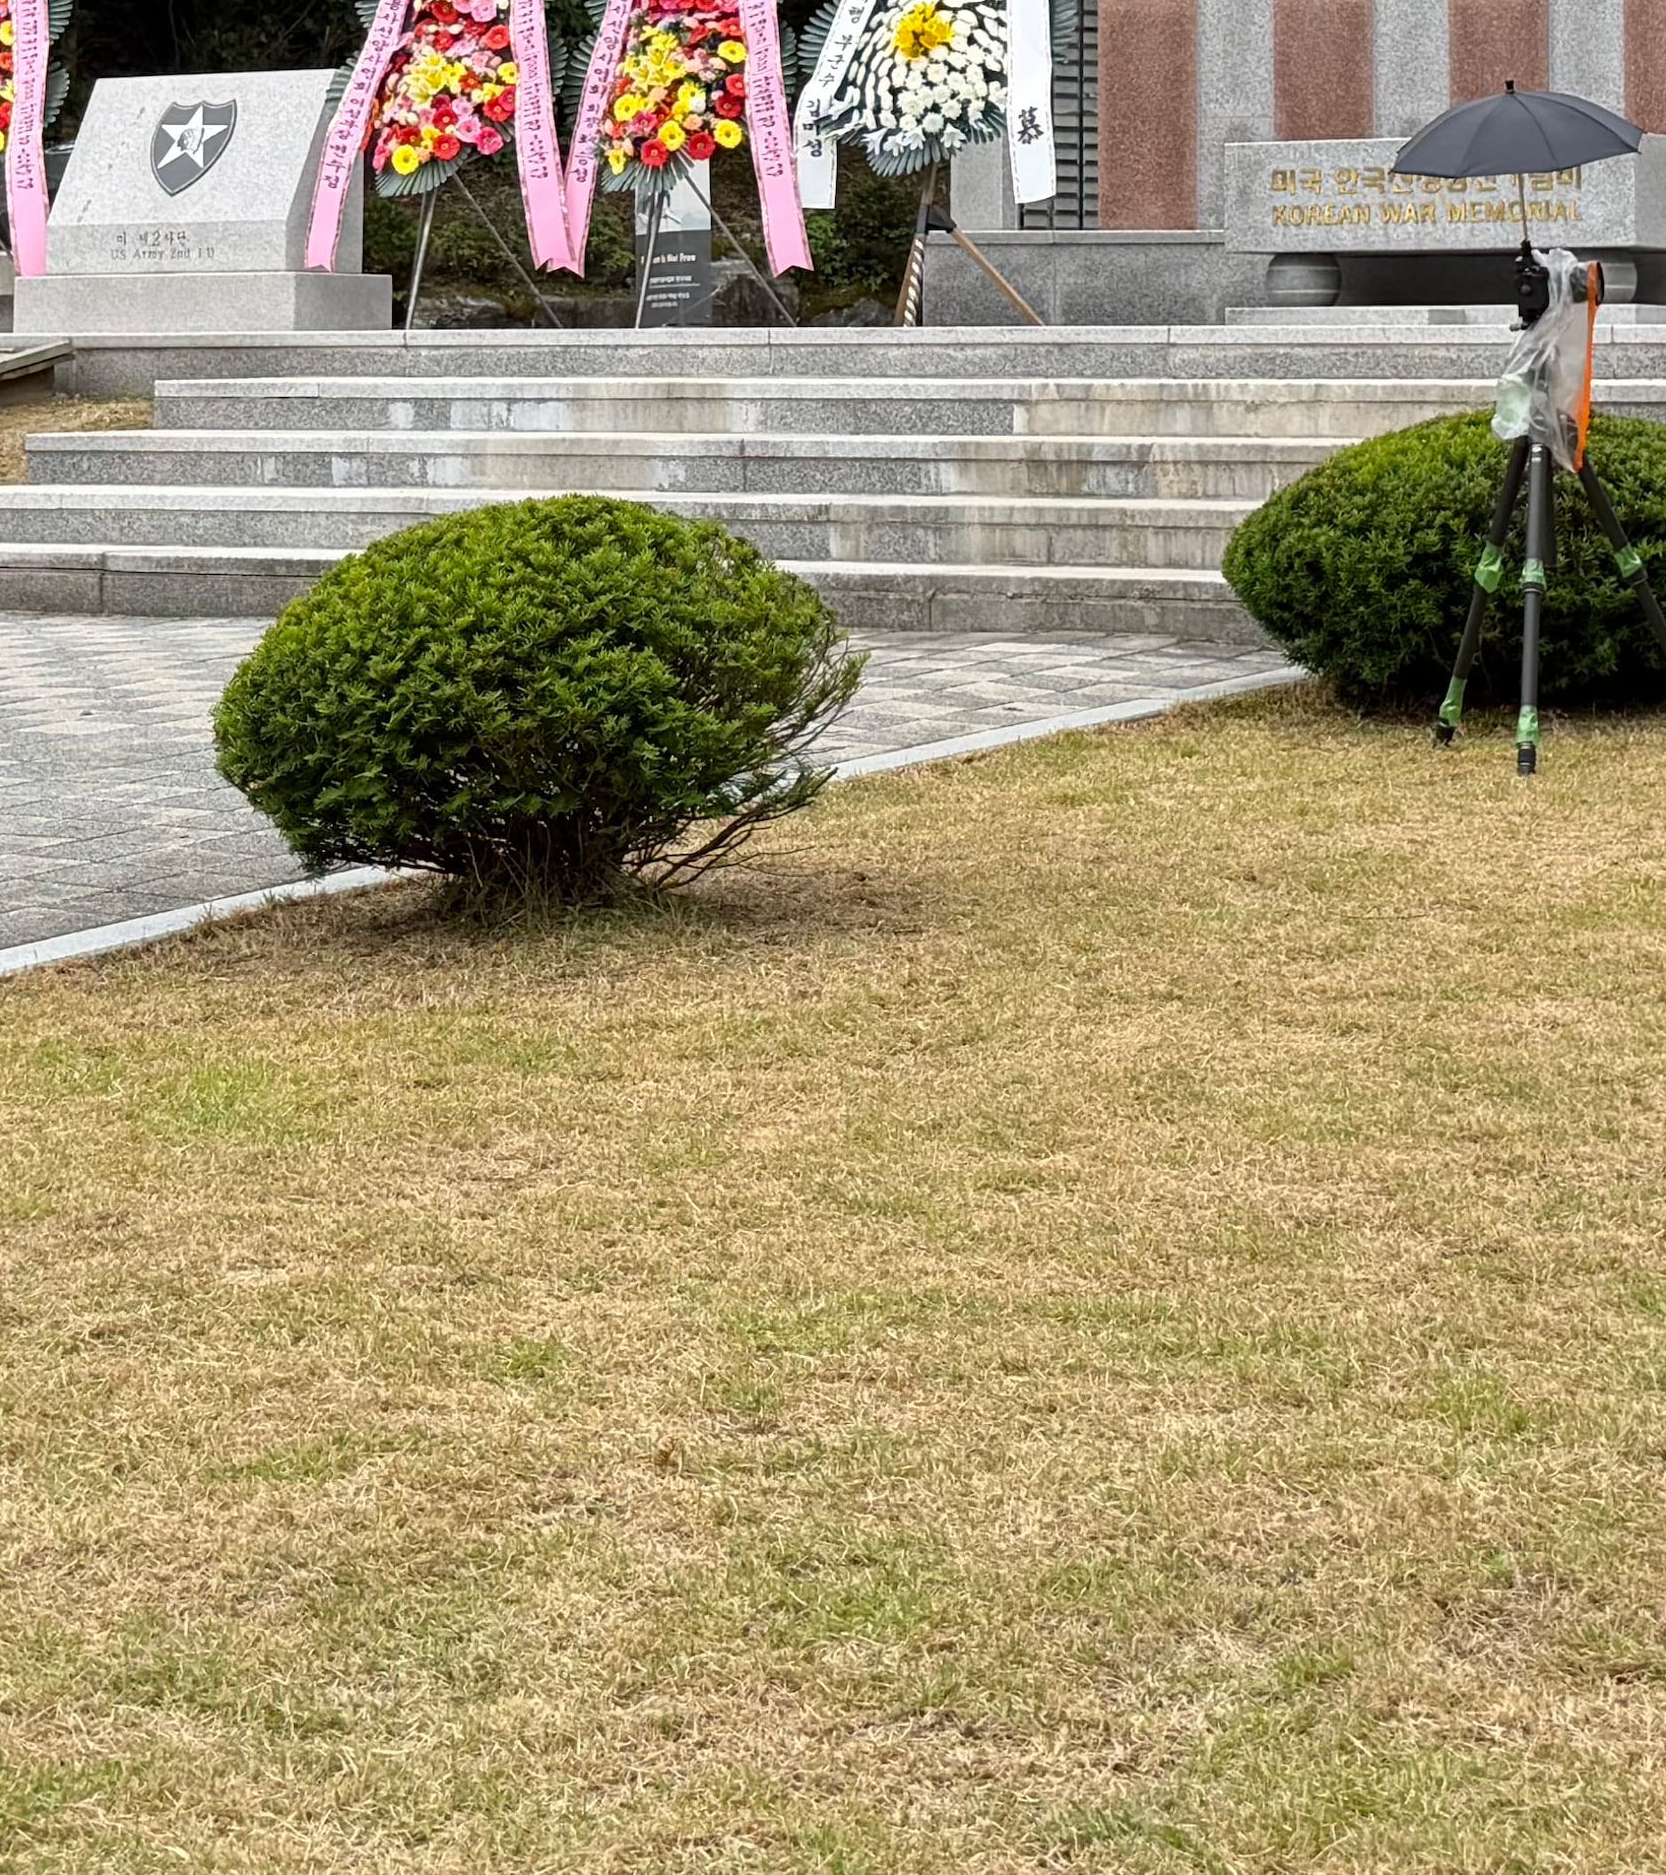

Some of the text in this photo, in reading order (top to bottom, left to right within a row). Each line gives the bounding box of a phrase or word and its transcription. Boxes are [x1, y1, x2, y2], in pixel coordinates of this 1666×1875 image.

[1272, 199, 1582, 227] KOREAN WAR MEMORIAL
